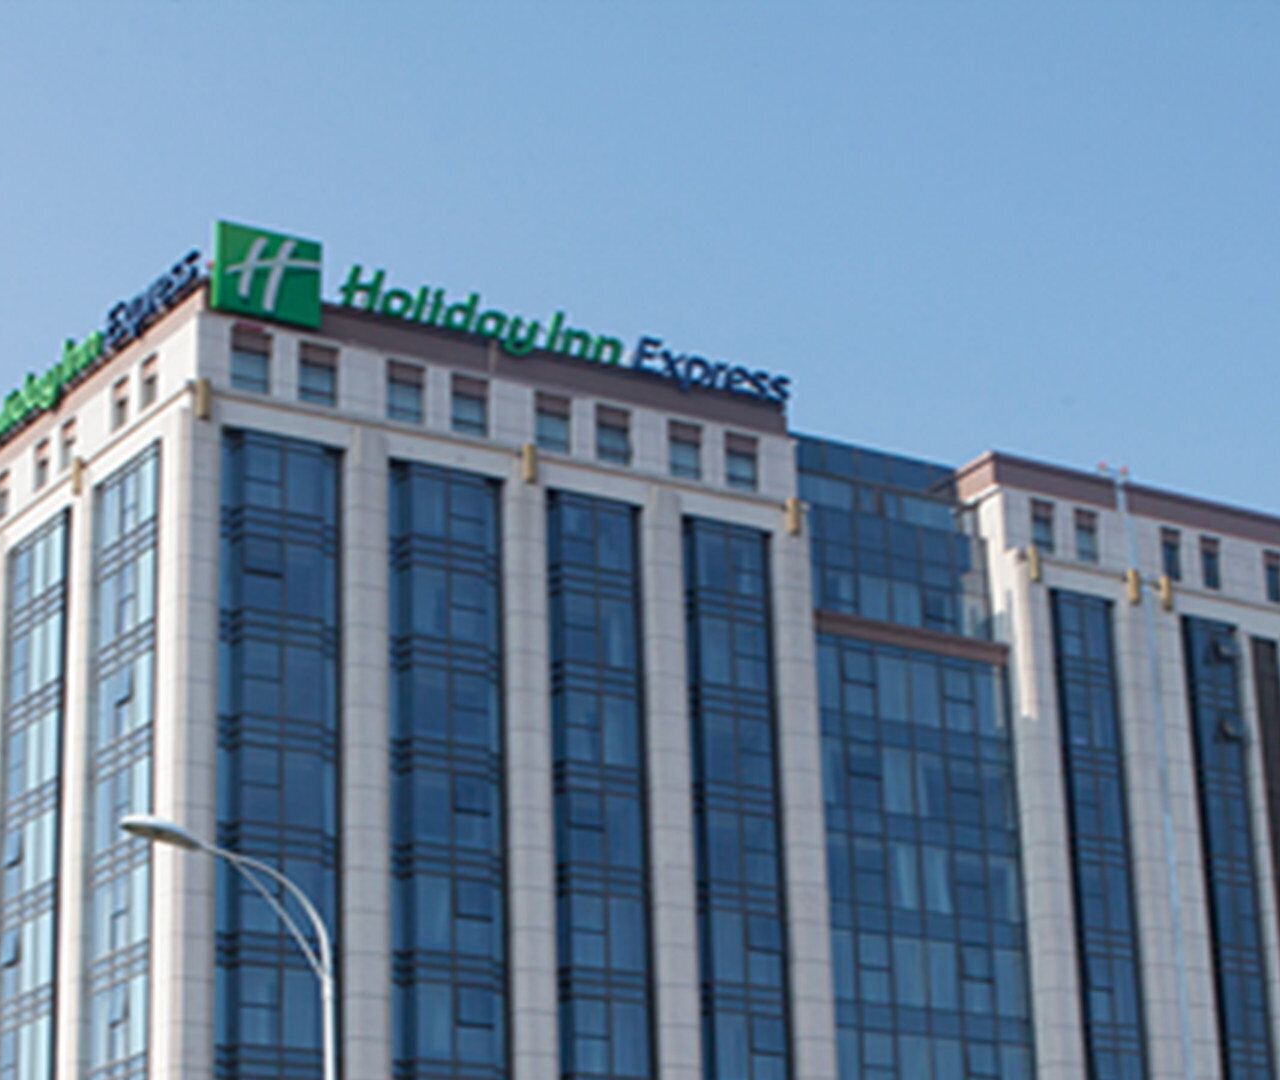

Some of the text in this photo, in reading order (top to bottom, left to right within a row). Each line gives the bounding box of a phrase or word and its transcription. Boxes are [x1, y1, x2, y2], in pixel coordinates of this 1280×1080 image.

[339, 263, 792, 406] Holiday Inn Express
